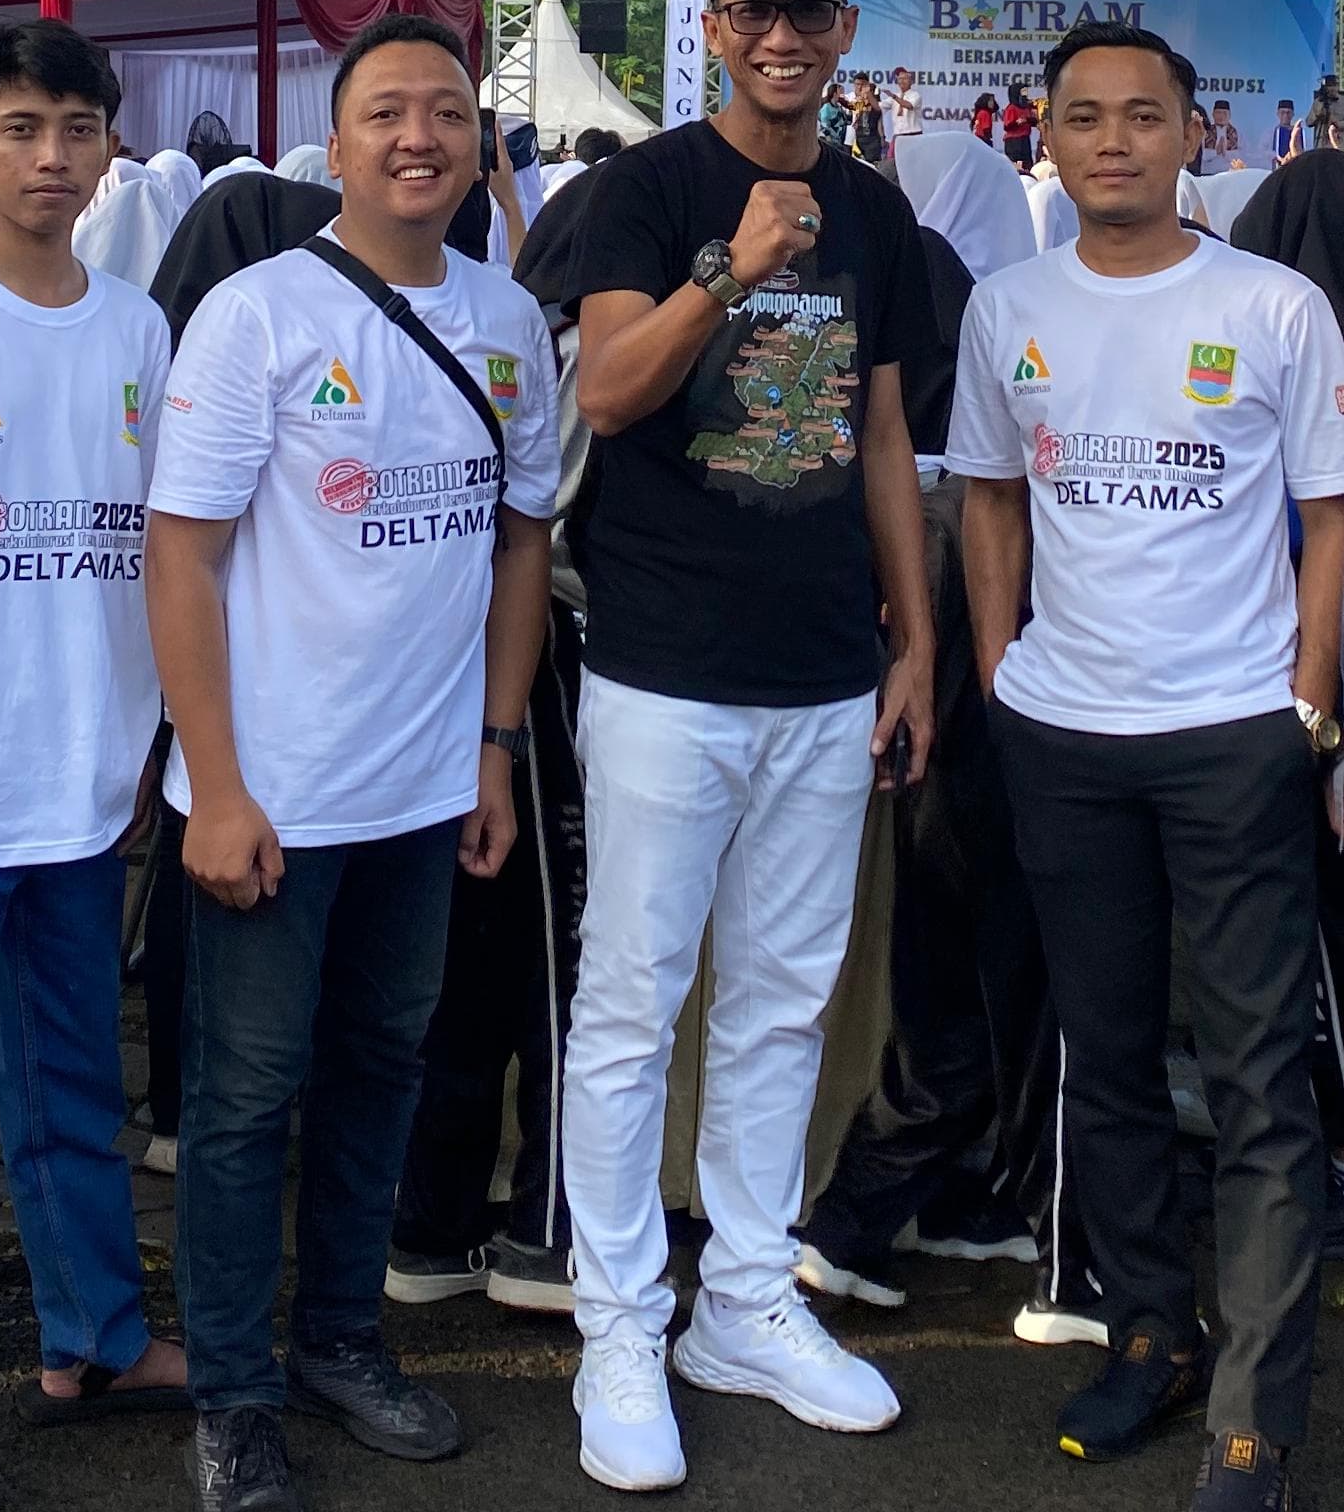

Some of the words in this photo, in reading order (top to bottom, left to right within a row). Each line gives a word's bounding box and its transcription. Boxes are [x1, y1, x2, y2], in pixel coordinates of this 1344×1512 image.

[929, 31, 1033, 42] BERKOLABORASI
[953, 48, 1034, 65] BERSAMA
[1013, 384, 1052, 397] Deltamas
[311, 408, 366, 422] Deltamas
[1054, 432, 1152, 464] BOTRAM
[1156, 441, 1225, 470] 2025
[361, 460, 463, 500] BOTRAM
[465, 453, 501, 487] 202
[1053, 480, 1225, 512] DELTAMAS
